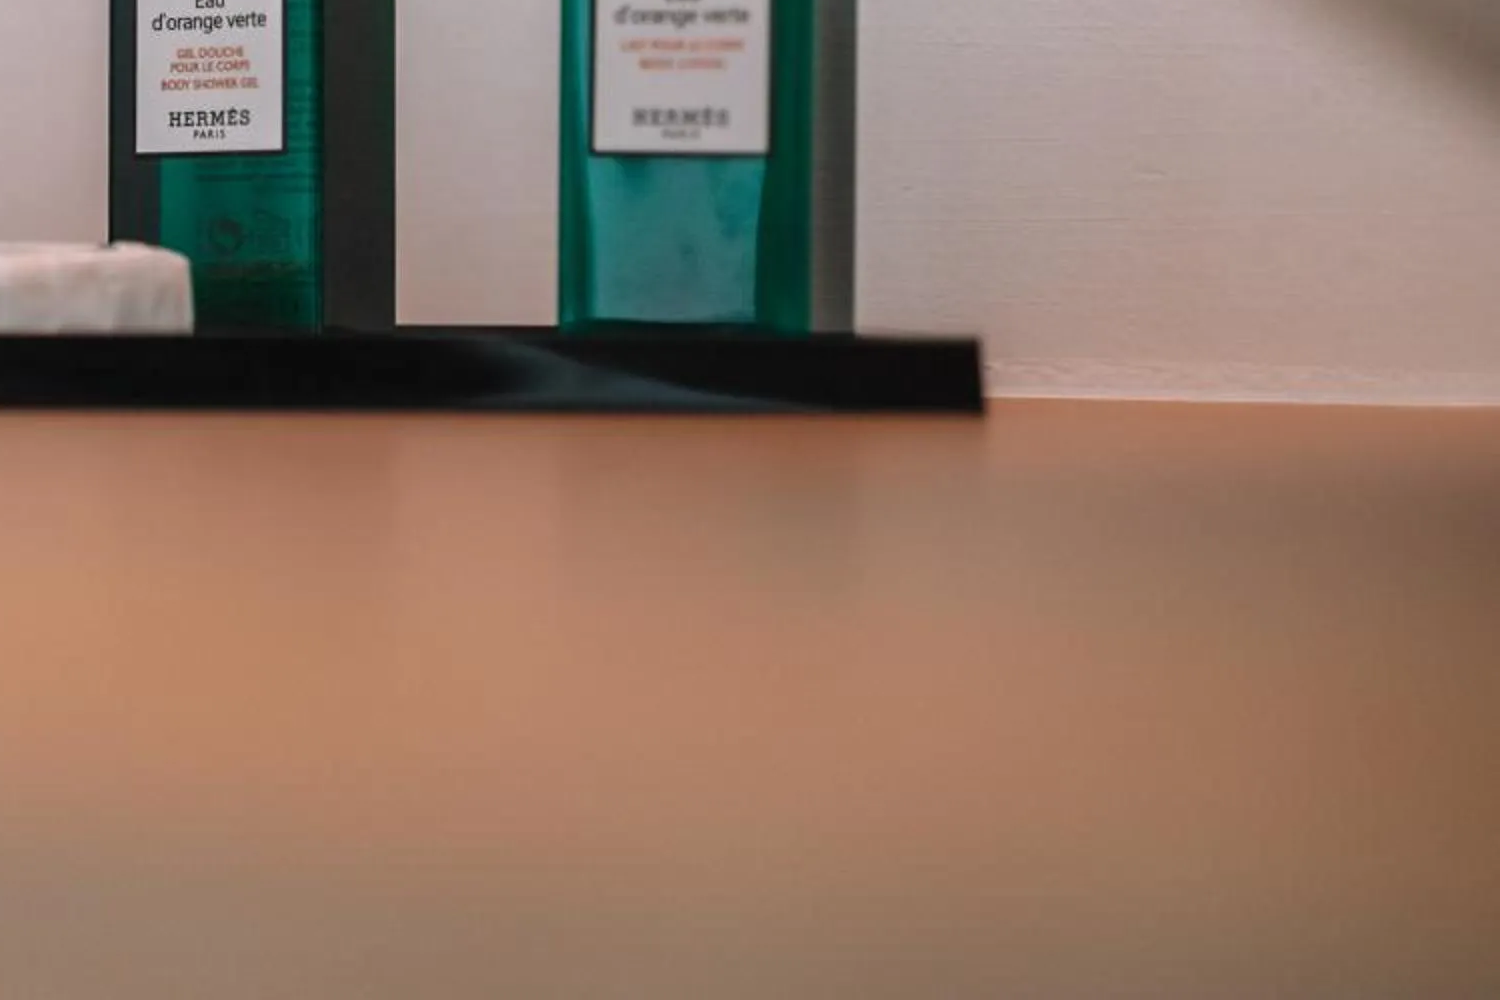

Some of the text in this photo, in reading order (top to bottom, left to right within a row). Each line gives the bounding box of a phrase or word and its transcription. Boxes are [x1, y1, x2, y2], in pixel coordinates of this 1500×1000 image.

[151, 11, 267, 34] d'orange verte
[176, 46, 244, 59] GEL DOUCHE
[170, 60, 250, 73] POUR LE CORPS
[161, 77, 260, 91] BODY SHOWER GEL
[193, 129, 226, 140] PARIS
